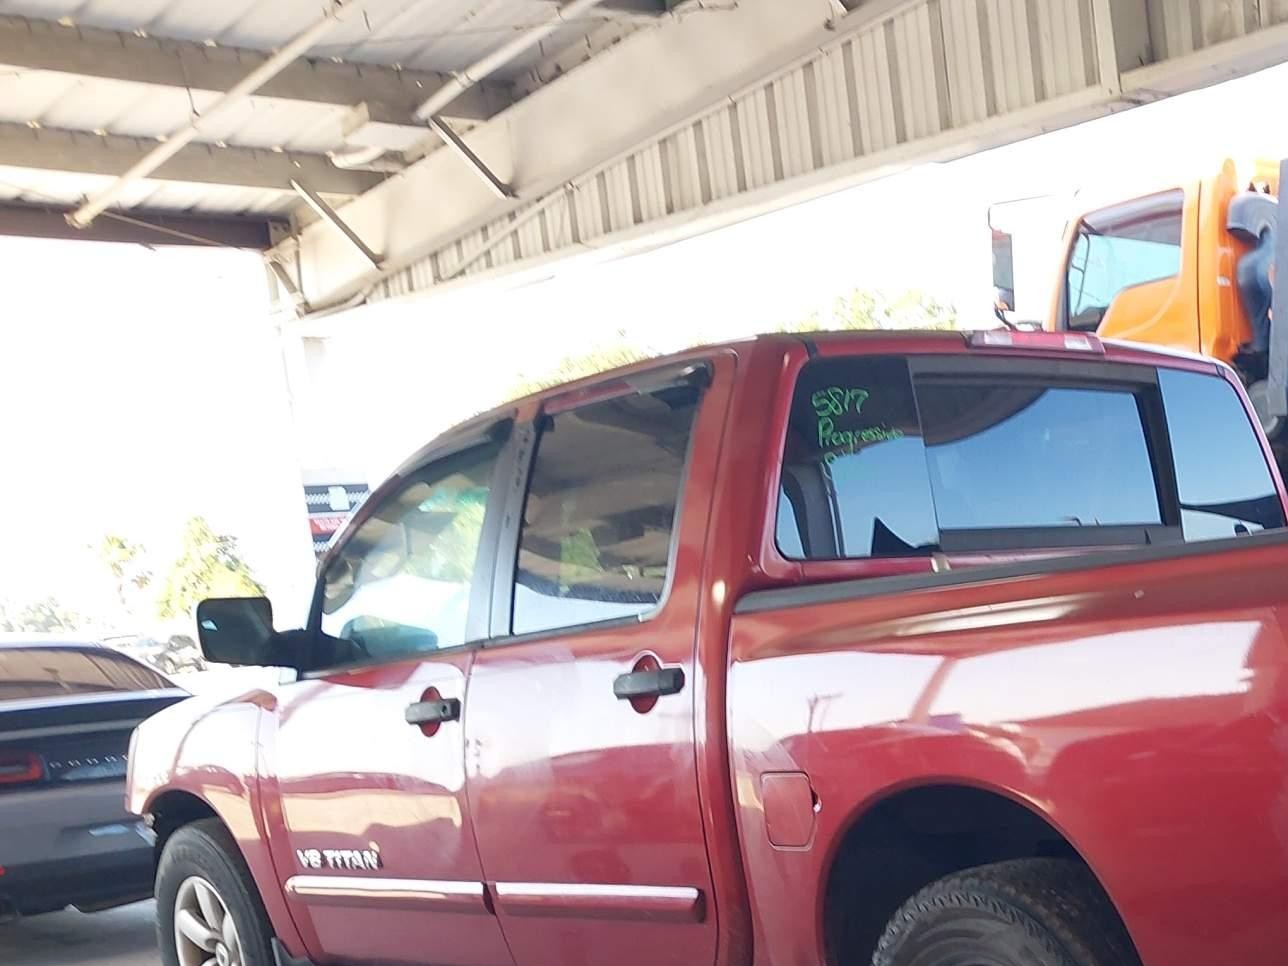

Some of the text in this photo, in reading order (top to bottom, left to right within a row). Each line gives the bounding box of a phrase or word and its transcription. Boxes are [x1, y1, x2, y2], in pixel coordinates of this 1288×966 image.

[812, 387, 869, 416] 5817
[296, 849, 381, 871] V8 TITAN
